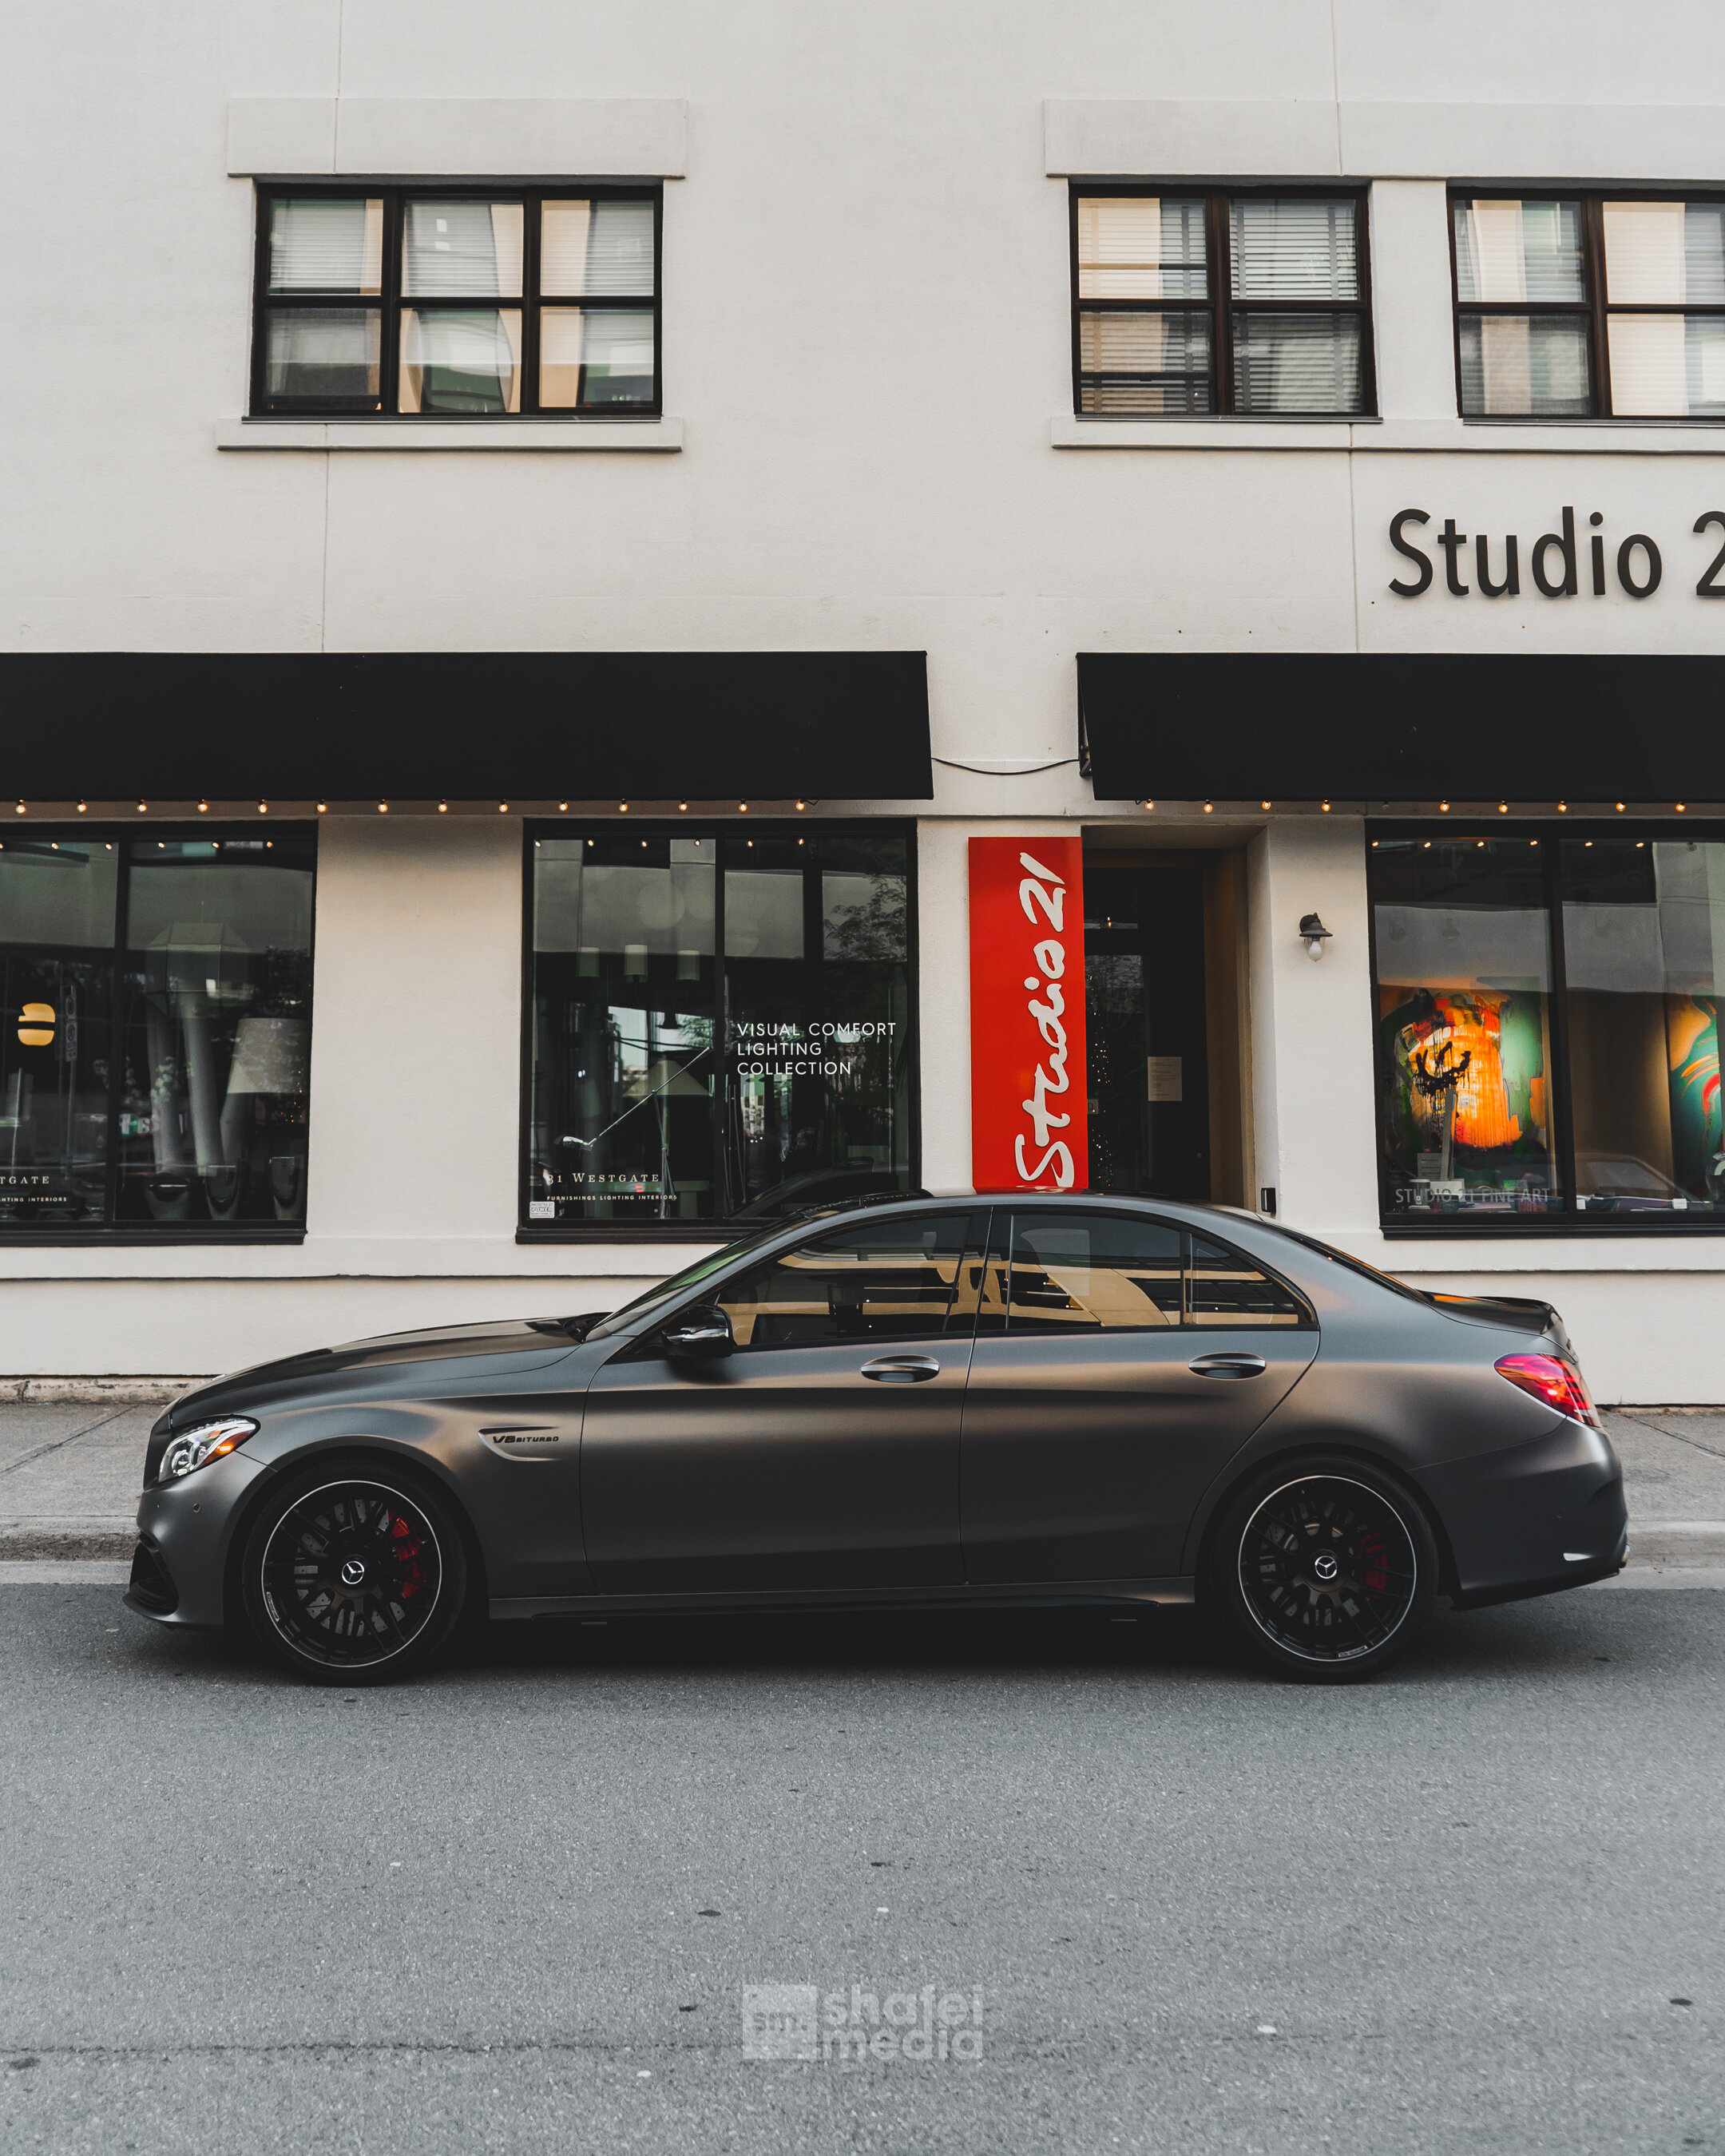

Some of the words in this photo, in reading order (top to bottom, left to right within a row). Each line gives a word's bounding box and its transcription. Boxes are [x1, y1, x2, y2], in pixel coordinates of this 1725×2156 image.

[1388, 505, 1663, 598] Studio
[1018, 852, 1067, 933] 21
[737, 1023, 800, 1036] VISUAL
[808, 1022, 896, 1036] COMFORT
[737, 1043, 822, 1056] LIGHTING
[737, 1062, 851, 1075] COLLECTION
[1015, 938, 1075, 1187] Studio
[572, 1172, 659, 1183] WESTGATE
[1395, 1188, 1452, 1203] STUDIO
[1482, 1188, 1516, 1203] FINE
[1520, 1187, 1550, 1203] ART
